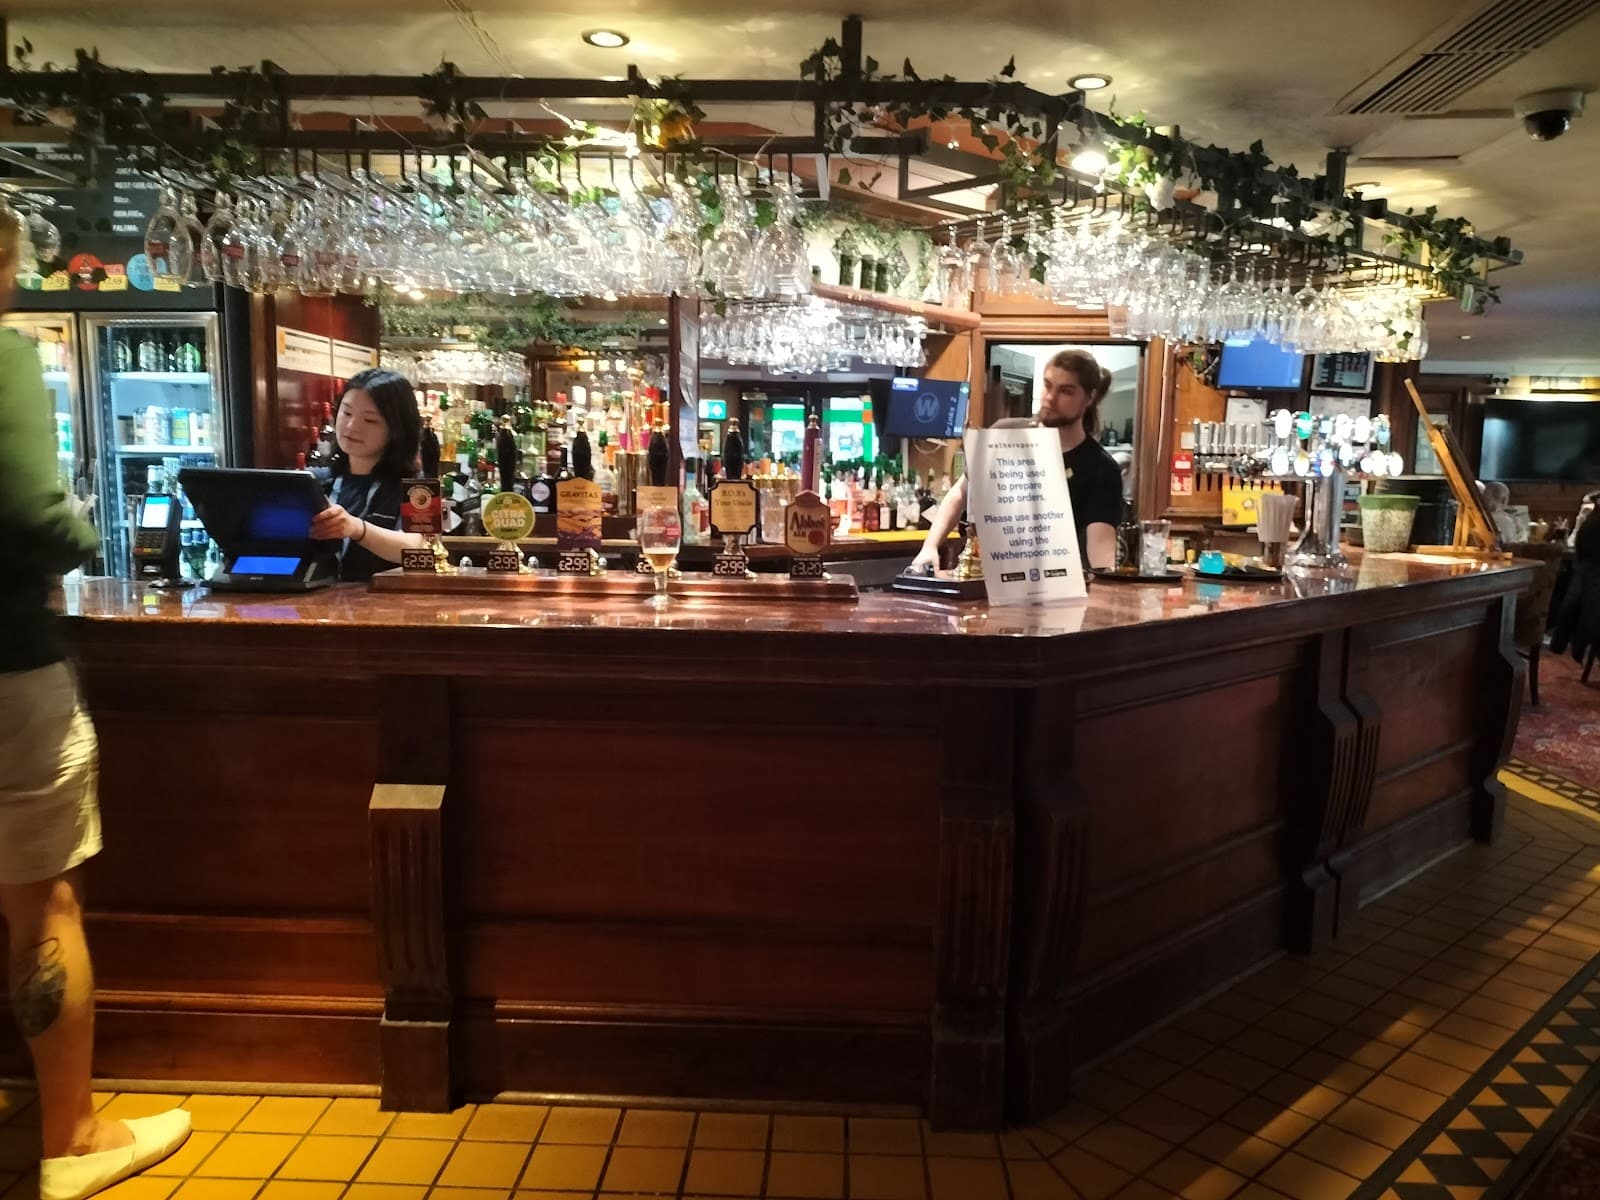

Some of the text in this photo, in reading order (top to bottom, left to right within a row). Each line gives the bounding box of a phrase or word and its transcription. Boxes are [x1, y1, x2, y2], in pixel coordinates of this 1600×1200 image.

[916, 397, 938, 418] W
[996, 458, 1036, 466] This area
[989, 469, 1045, 481] is being used
[997, 482, 1042, 492] to prepare
[560, 490, 599, 499] GRAVITAS
[997, 494, 1046, 504] app orders.
[491, 510, 526, 518] CITRA
[984, 514, 1013, 523] Please
[1032, 511, 1064, 520] another
[494, 518, 526, 528] QUAD
[790, 511, 825, 530] Abbot
[1002, 526, 1014, 535] till
[1028, 524, 1051, 532] order
[1009, 536, 1049, 547] using the
[990, 548, 1070, 560] Wetherspoon app.
[403, 554, 435, 568] £2.99
[487, 556, 518, 569] £2.99
[559, 557, 590, 571] £2.99
[714, 560, 745, 574] £2.99
[791, 562, 822, 575] £3.20
